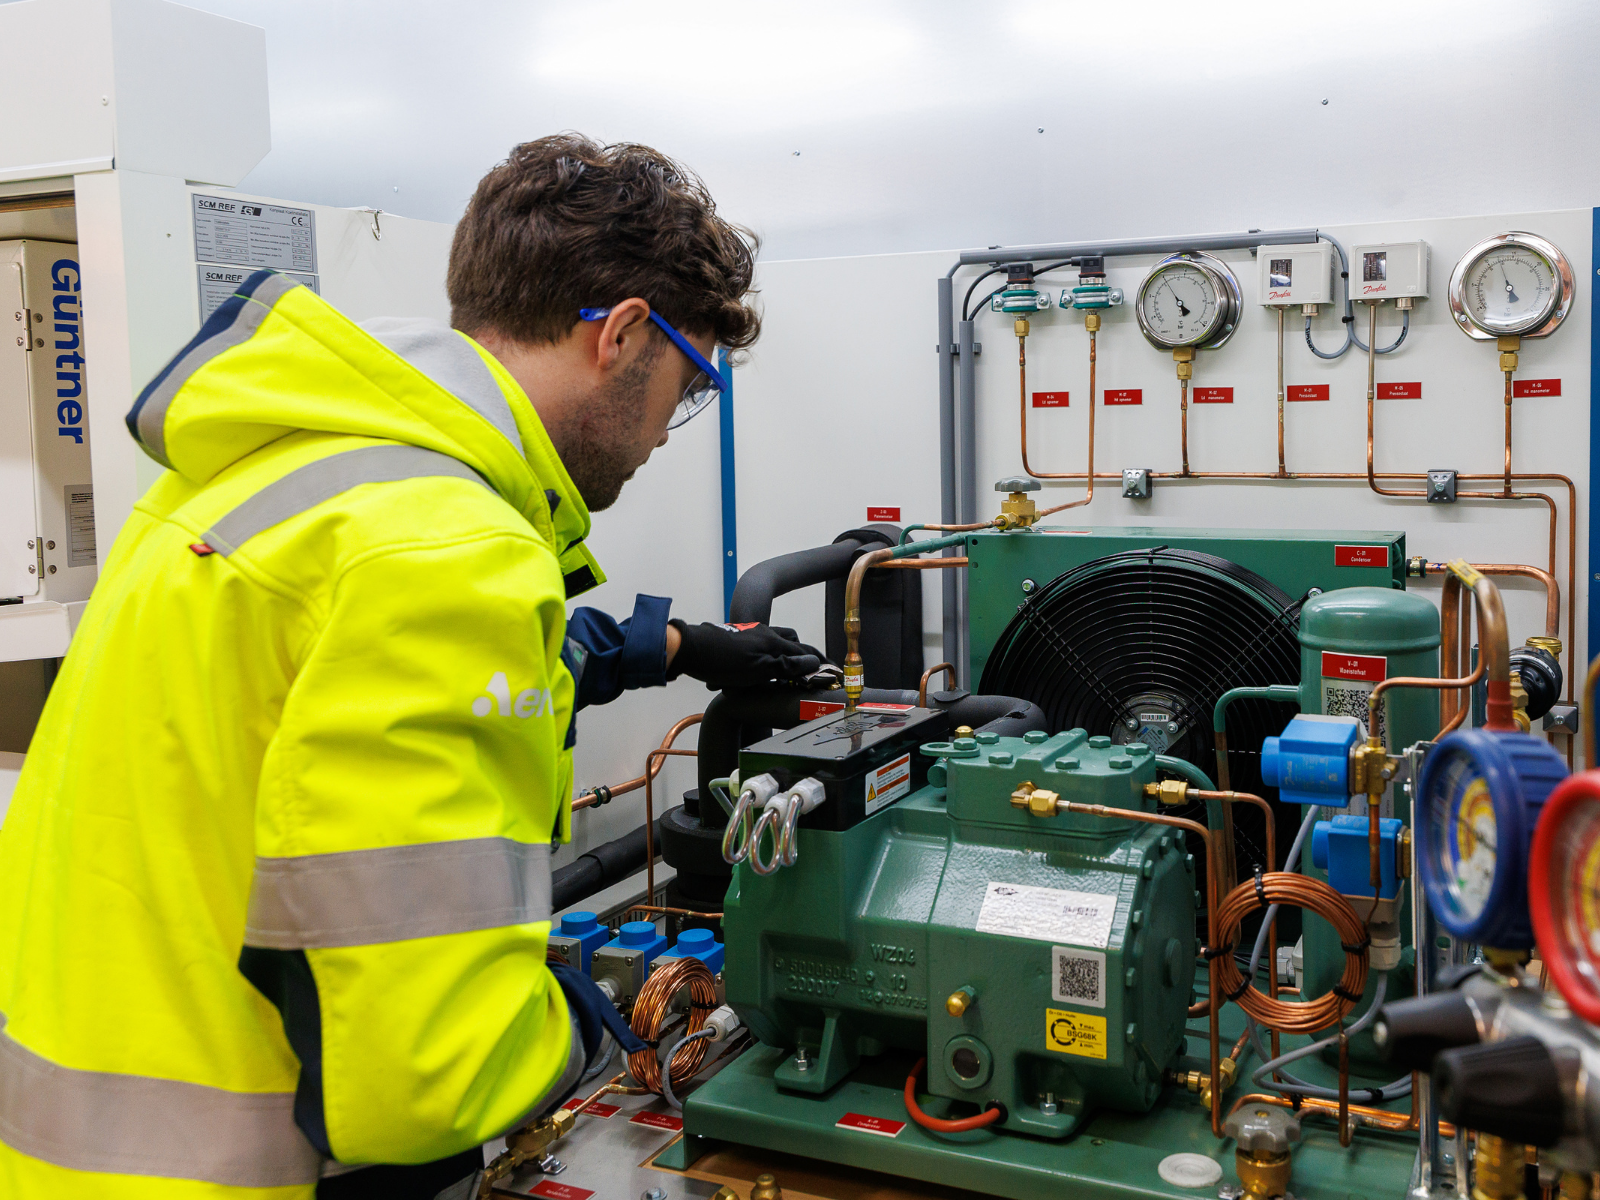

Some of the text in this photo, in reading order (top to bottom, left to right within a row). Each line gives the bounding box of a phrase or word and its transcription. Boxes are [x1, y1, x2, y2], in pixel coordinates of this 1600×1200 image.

[198, 200, 216, 208] SCM
[291, 216, 303, 226] CE
[205, 272, 223, 280] SCM
[1363, 284, 1387, 294] Danfoss
[1269, 289, 1292, 300] Danfoss
[51, 258, 85, 445] Güntner
[1067, 1030, 1097, 1041] BSG68K
